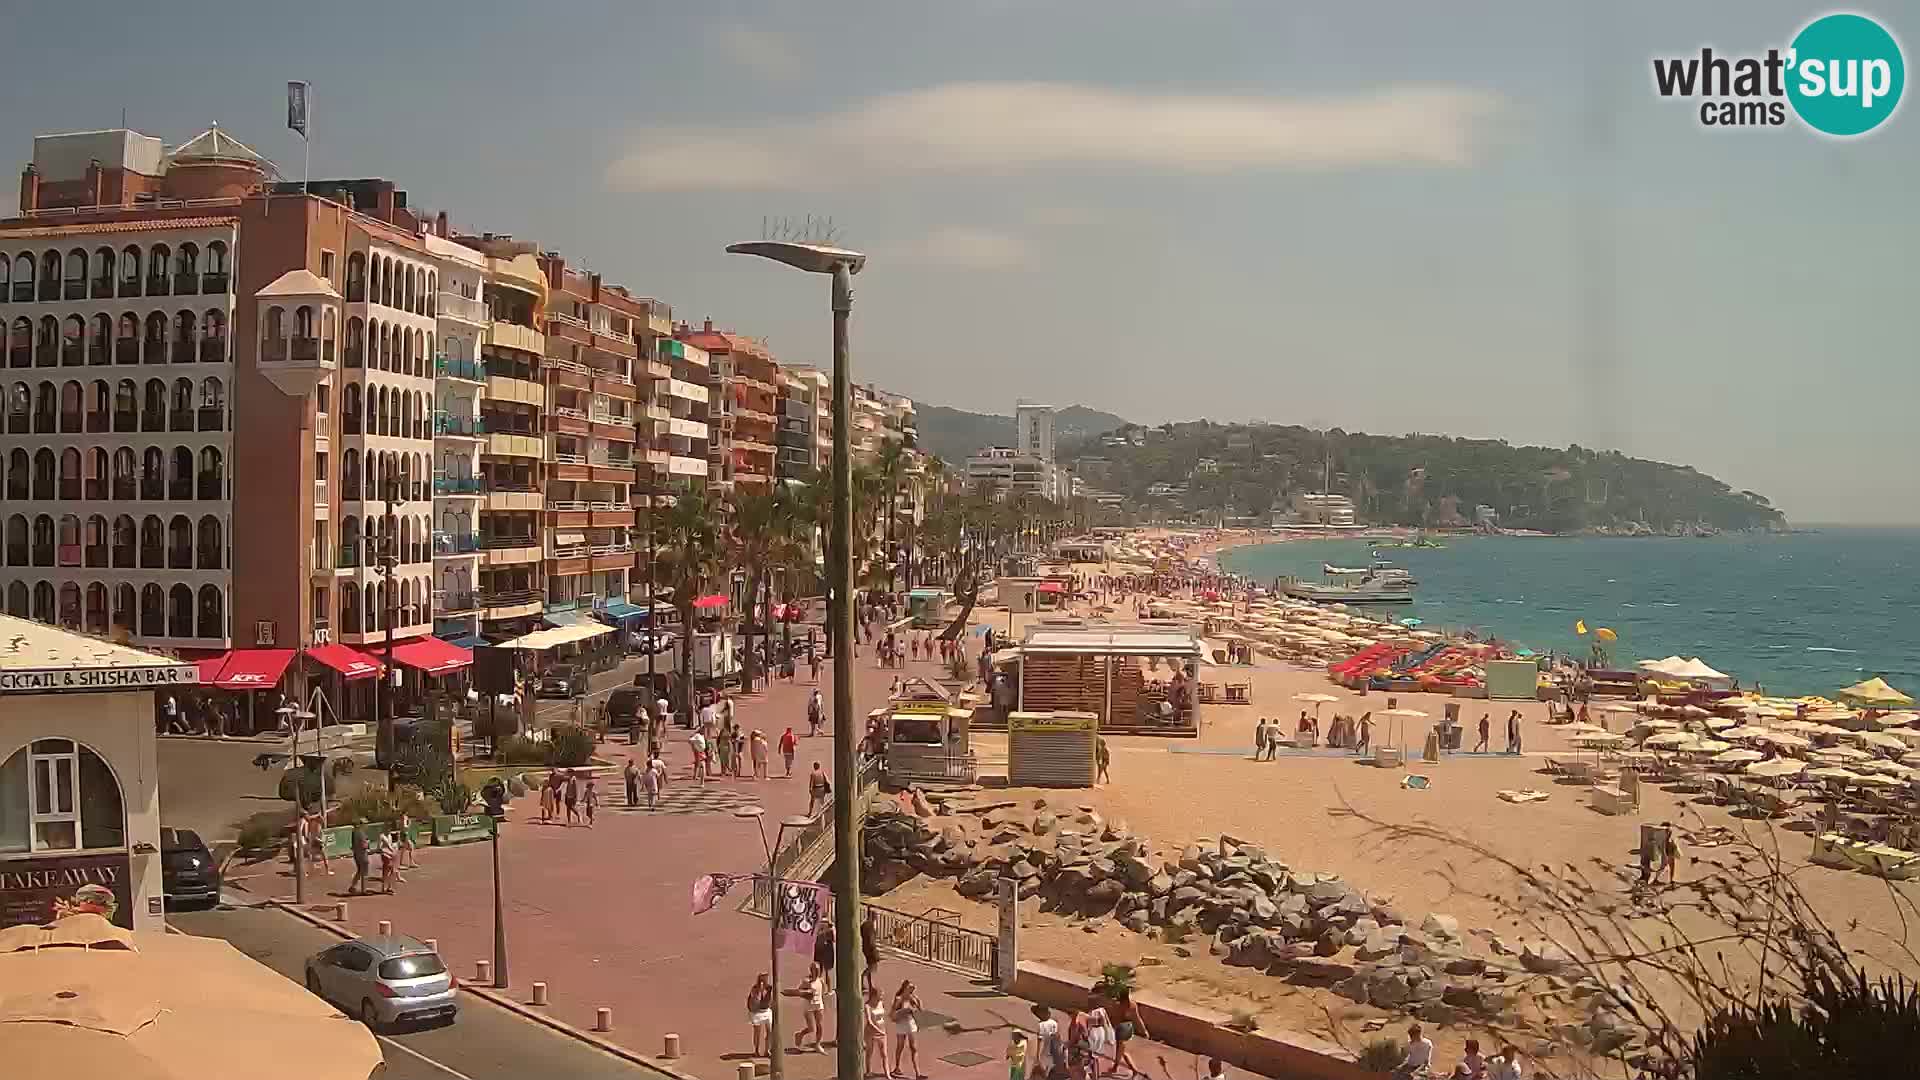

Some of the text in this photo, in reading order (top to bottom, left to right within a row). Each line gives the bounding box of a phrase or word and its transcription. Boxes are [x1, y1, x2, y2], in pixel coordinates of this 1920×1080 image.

[314, 628, 332, 645] KFC
[64, 672, 74, 685] &
[79, 670, 141, 686] SHISHA
[145, 668, 179, 683] BAR
[231, 673, 266, 682] KFC
